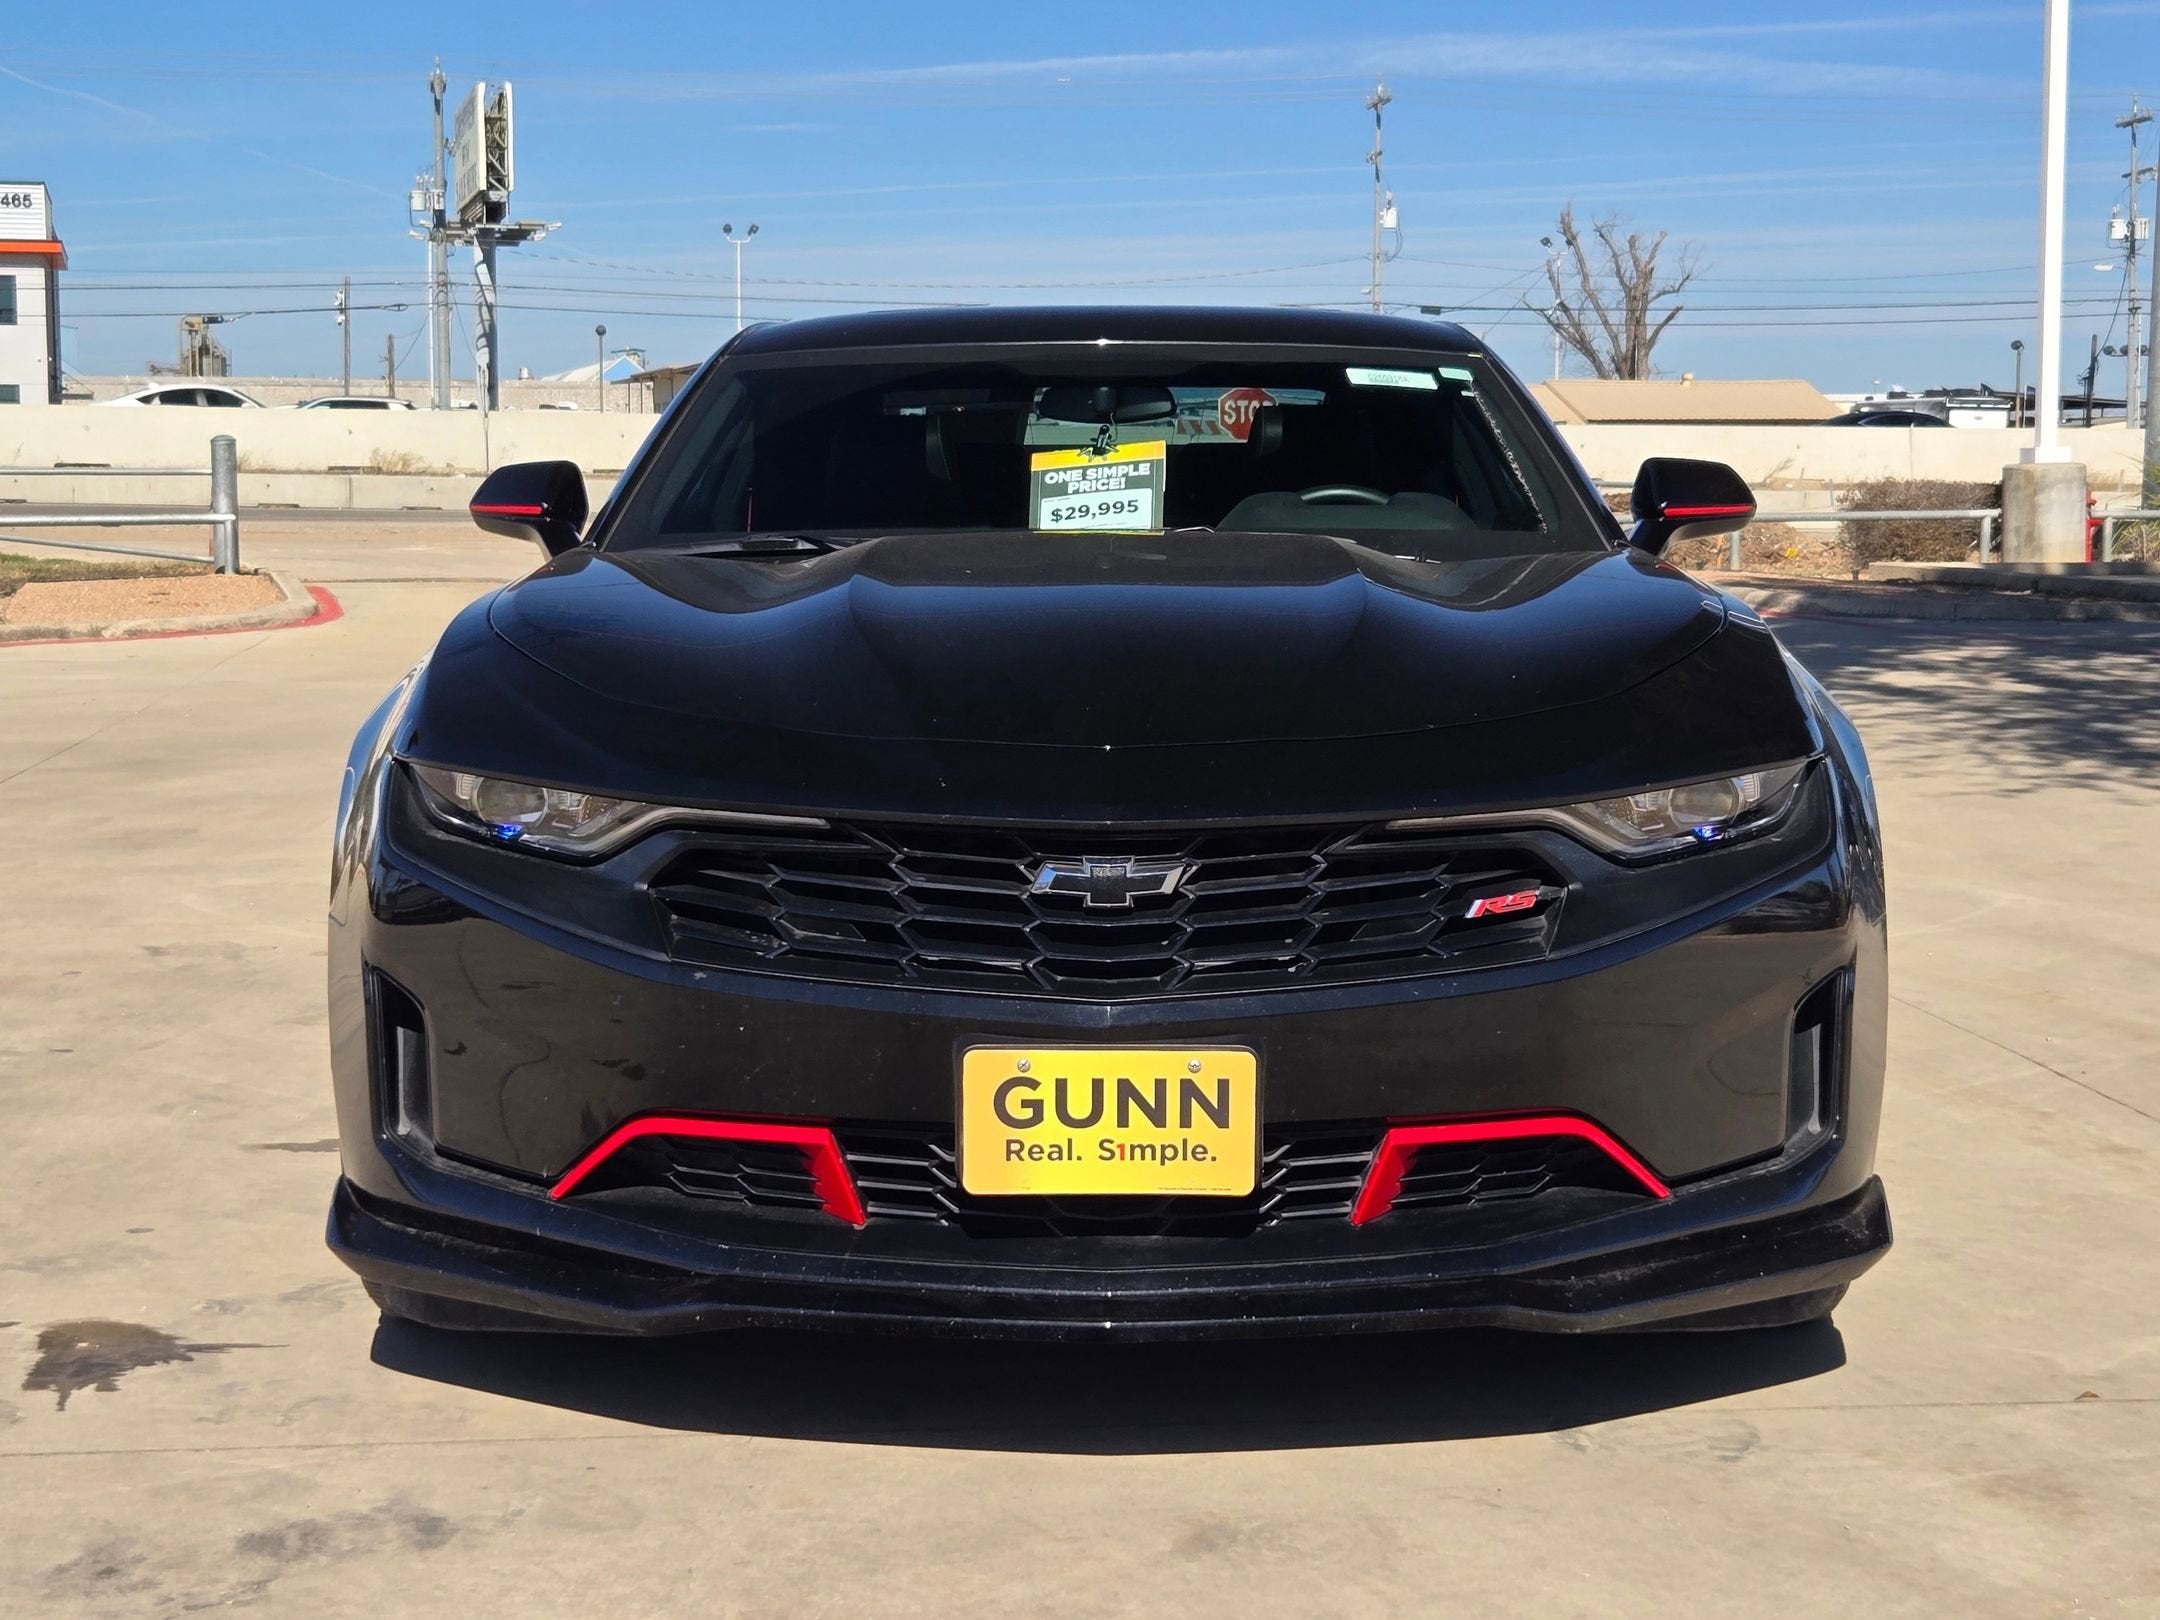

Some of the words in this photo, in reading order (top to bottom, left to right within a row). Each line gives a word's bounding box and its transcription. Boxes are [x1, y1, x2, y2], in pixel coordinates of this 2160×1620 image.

[0, 193, 32, 208] 465
[1044, 469, 1083, 484] ONE
[1086, 463, 1151, 480] SIMPLE
[1067, 477, 1126, 494] PRICE!
[1051, 499, 1139, 523] $29,995
[1465, 889, 1538, 918] RS
[993, 1076, 1230, 1130] GUNN
[1005, 1138, 1083, 1162] Real.
